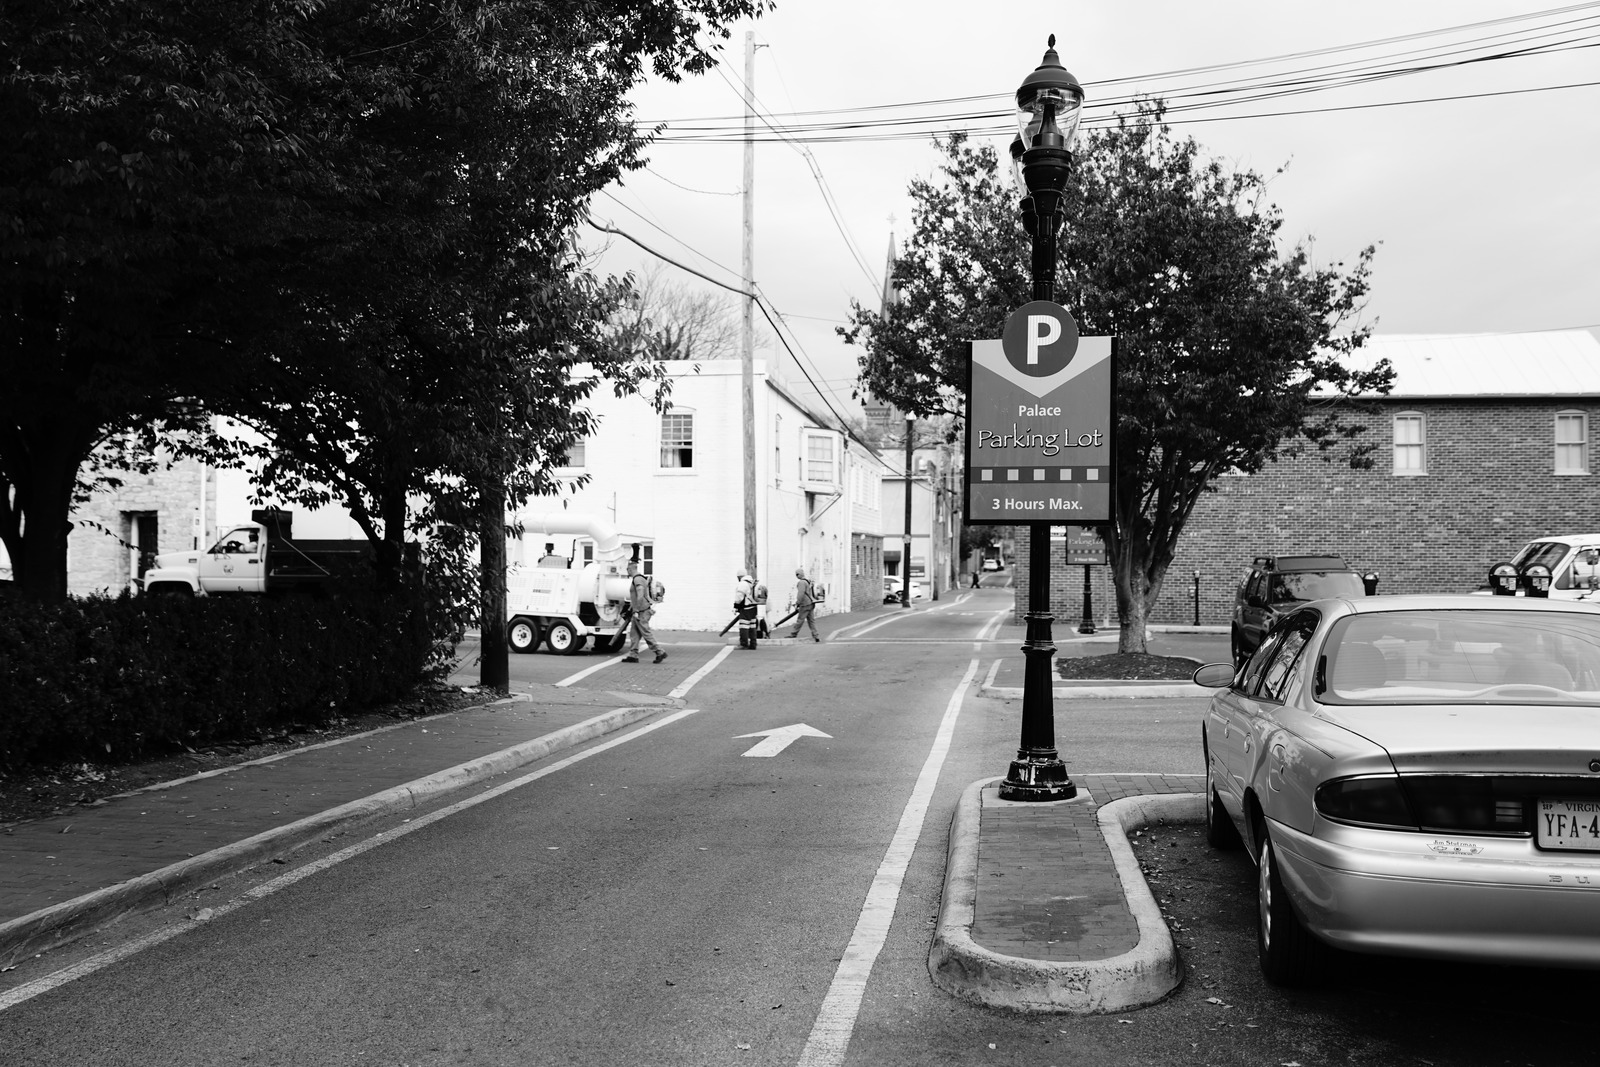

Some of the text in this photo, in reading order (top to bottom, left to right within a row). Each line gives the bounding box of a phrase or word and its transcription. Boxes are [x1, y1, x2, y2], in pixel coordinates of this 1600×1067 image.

[1027, 315, 1062, 364] P
[1018, 404, 1062, 417] Palace
[978, 423, 1103, 456] Parking Lot
[992, 498, 1083, 510] 3 Hours Max.
[1544, 813, 1600, 839] YFA-4
